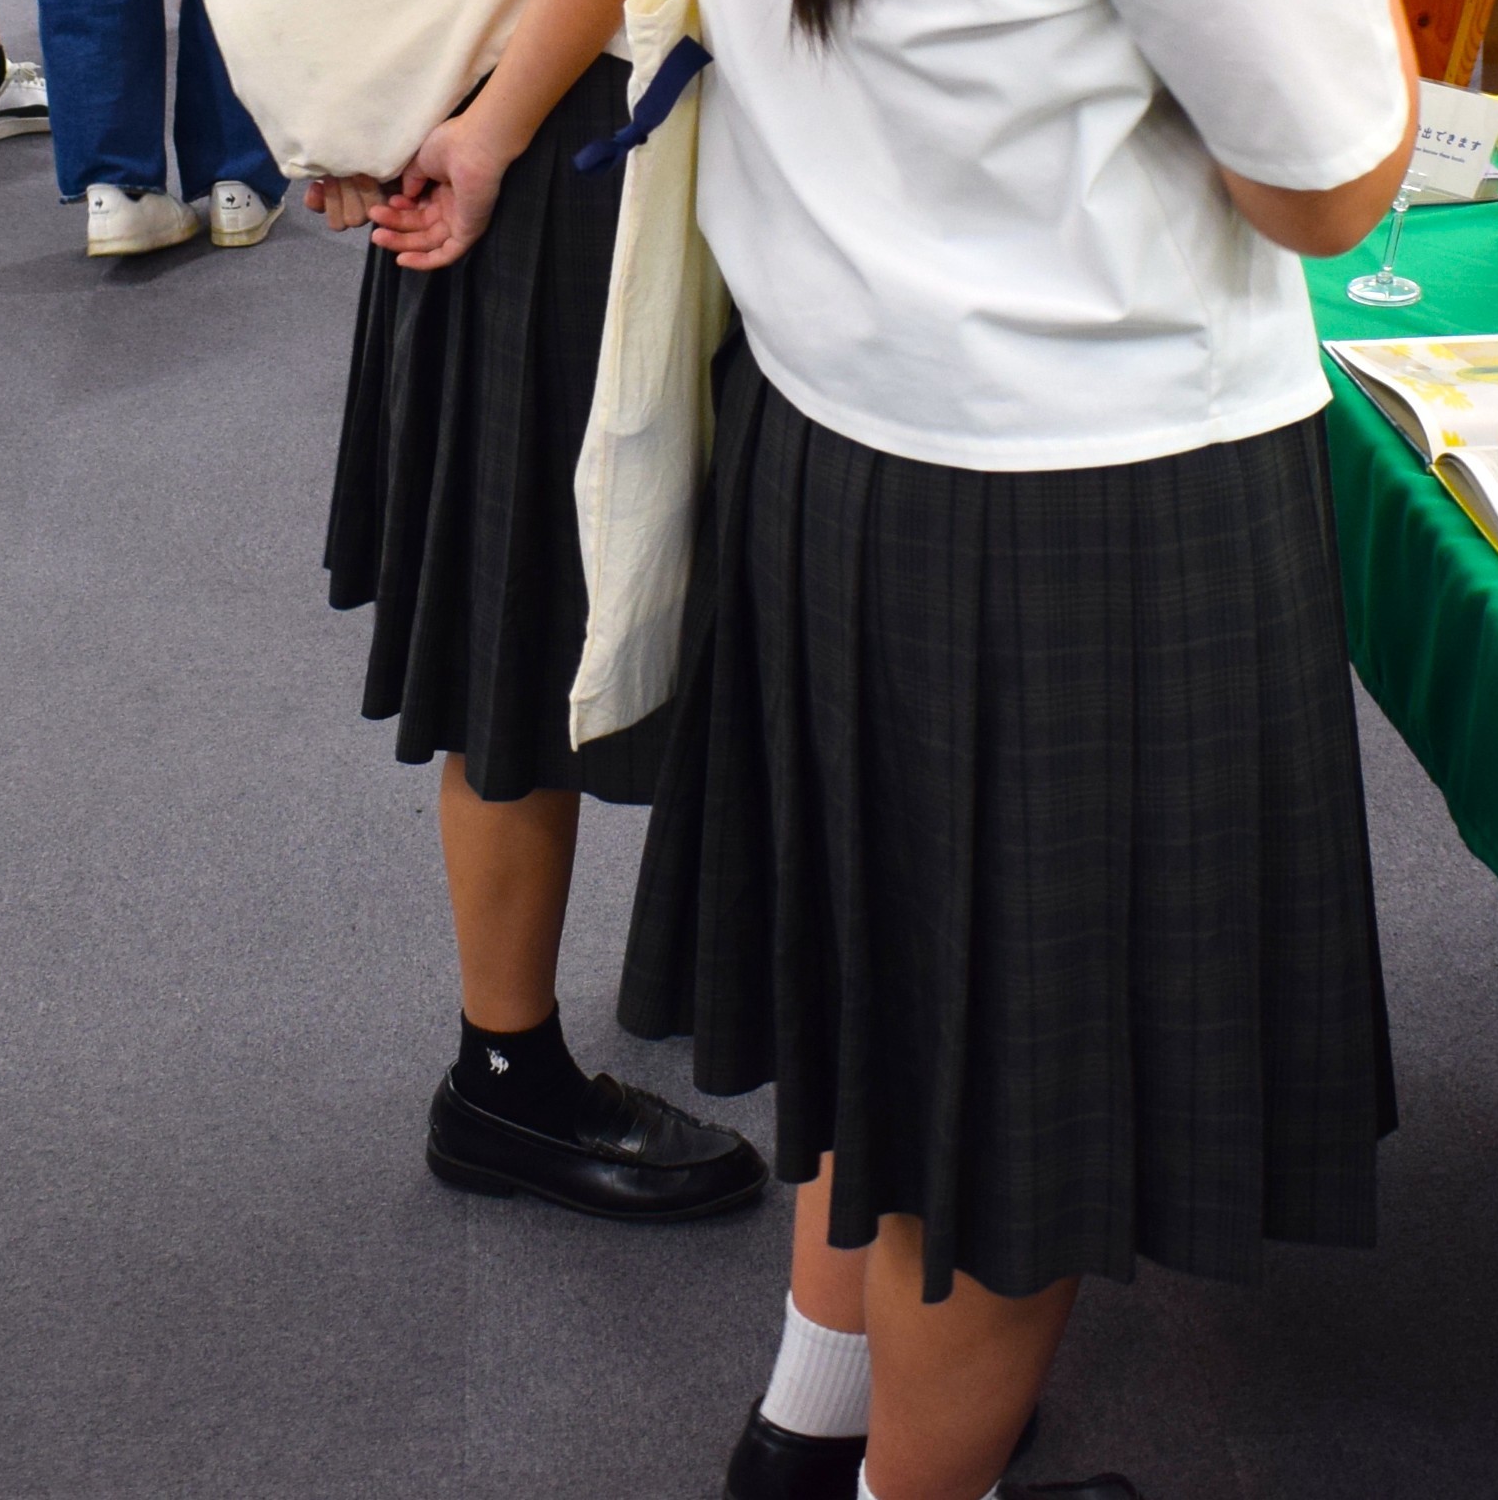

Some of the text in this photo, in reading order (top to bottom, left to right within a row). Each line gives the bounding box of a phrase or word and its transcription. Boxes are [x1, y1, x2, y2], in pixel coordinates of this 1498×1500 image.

[1418, 123, 1482, 151] 出できます
